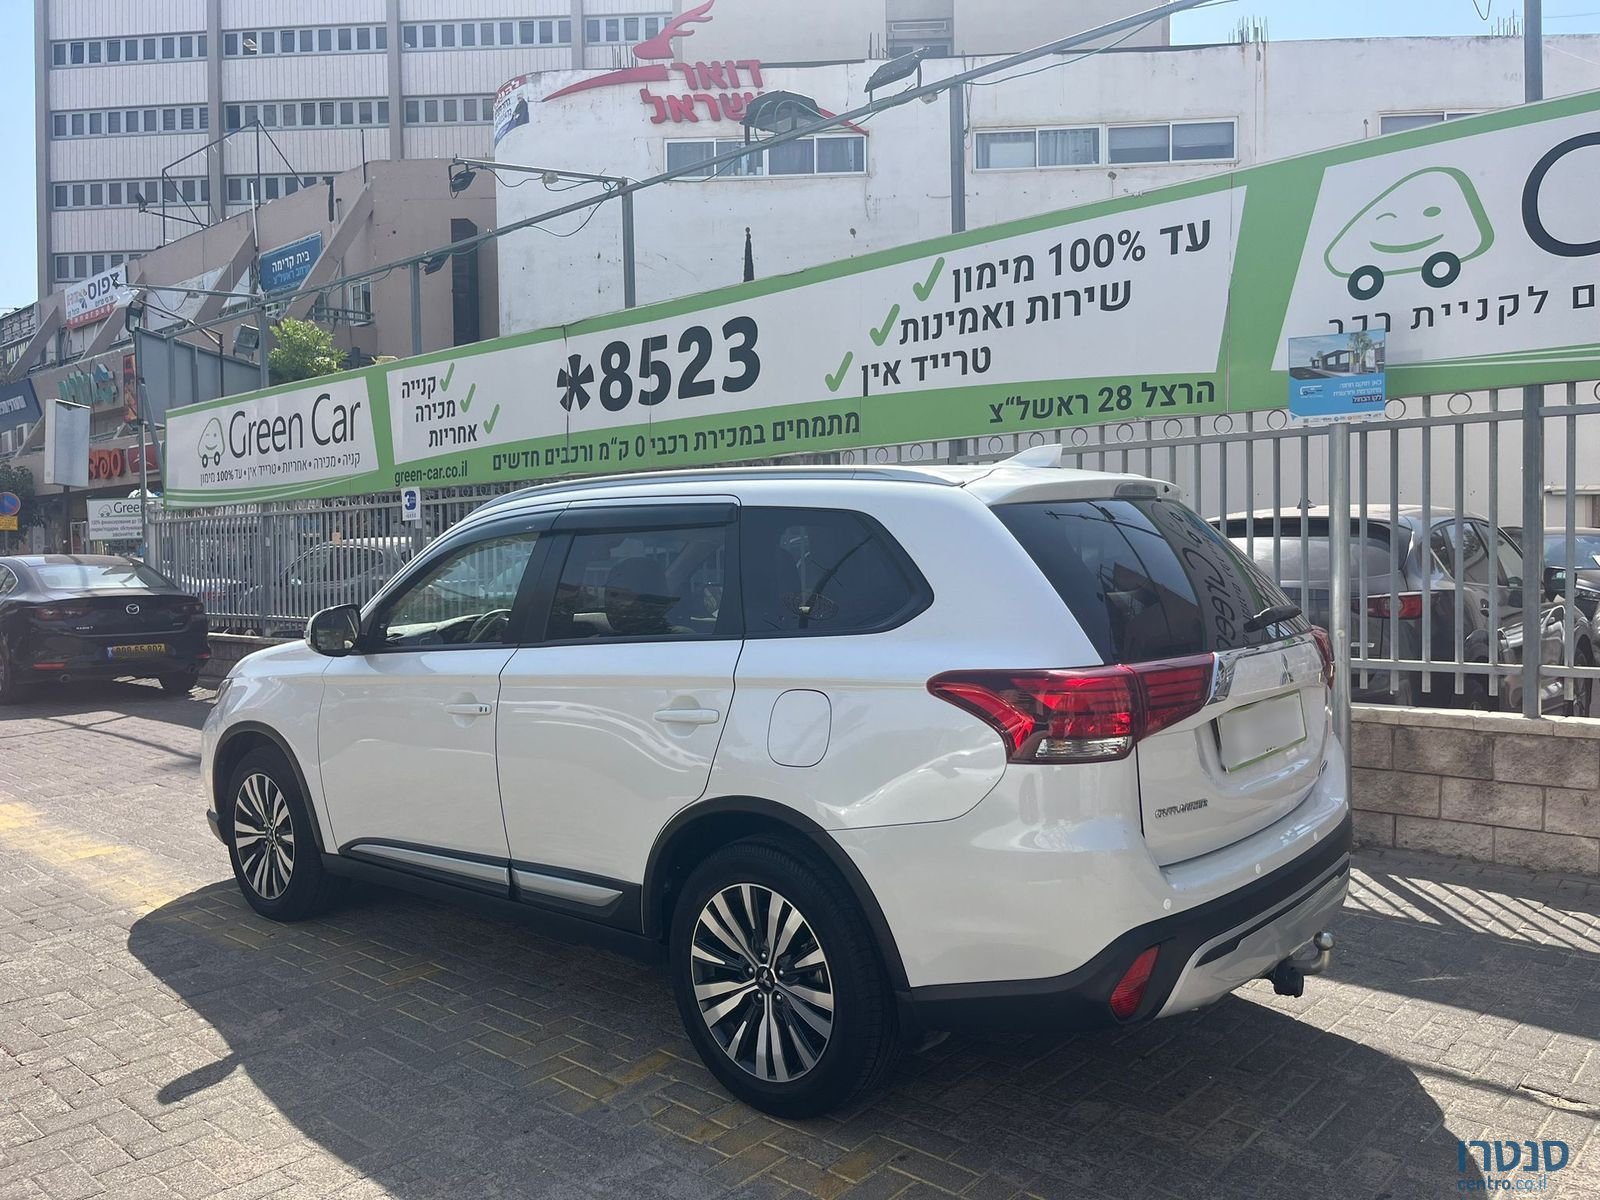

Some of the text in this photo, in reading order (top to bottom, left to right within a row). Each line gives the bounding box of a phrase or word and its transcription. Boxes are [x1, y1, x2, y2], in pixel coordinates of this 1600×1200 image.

[671, 60, 763, 90] דואר
[640, 89, 765, 124] שראל
[296, 251, 310, 264] בית
[952, 220, 1210, 302] עד 100% מימון
[900, 280, 1131, 344] שירות ואמינות
[1410, 286, 1548, 330] לקניית
[861, 346, 991, 396] טרייד אין
[402, 376, 436, 400] קנייה
[1098, 384, 1132, 412] 28
[1140, 380, 1214, 408] הרצל
[416, 400, 456, 422] מכירה
[229, 393, 360, 458] Green Car
[428, 424, 478, 448] אחריות
[694, 424, 766, 450] במכירת
[772, 412, 859, 442] מתמחים
[544, 444, 594, 466] ורכבים
[635, 439, 646, 457] 0
[650, 434, 688, 456] רכבי
[200, 452, 360, 486] קניה מכירה אחריות טרייד אין עד 100% מימון
[394, 461, 468, 487] green-car.co.il
[492, 450, 540, 471] חדשים
[114, 502, 142, 514] Gree
